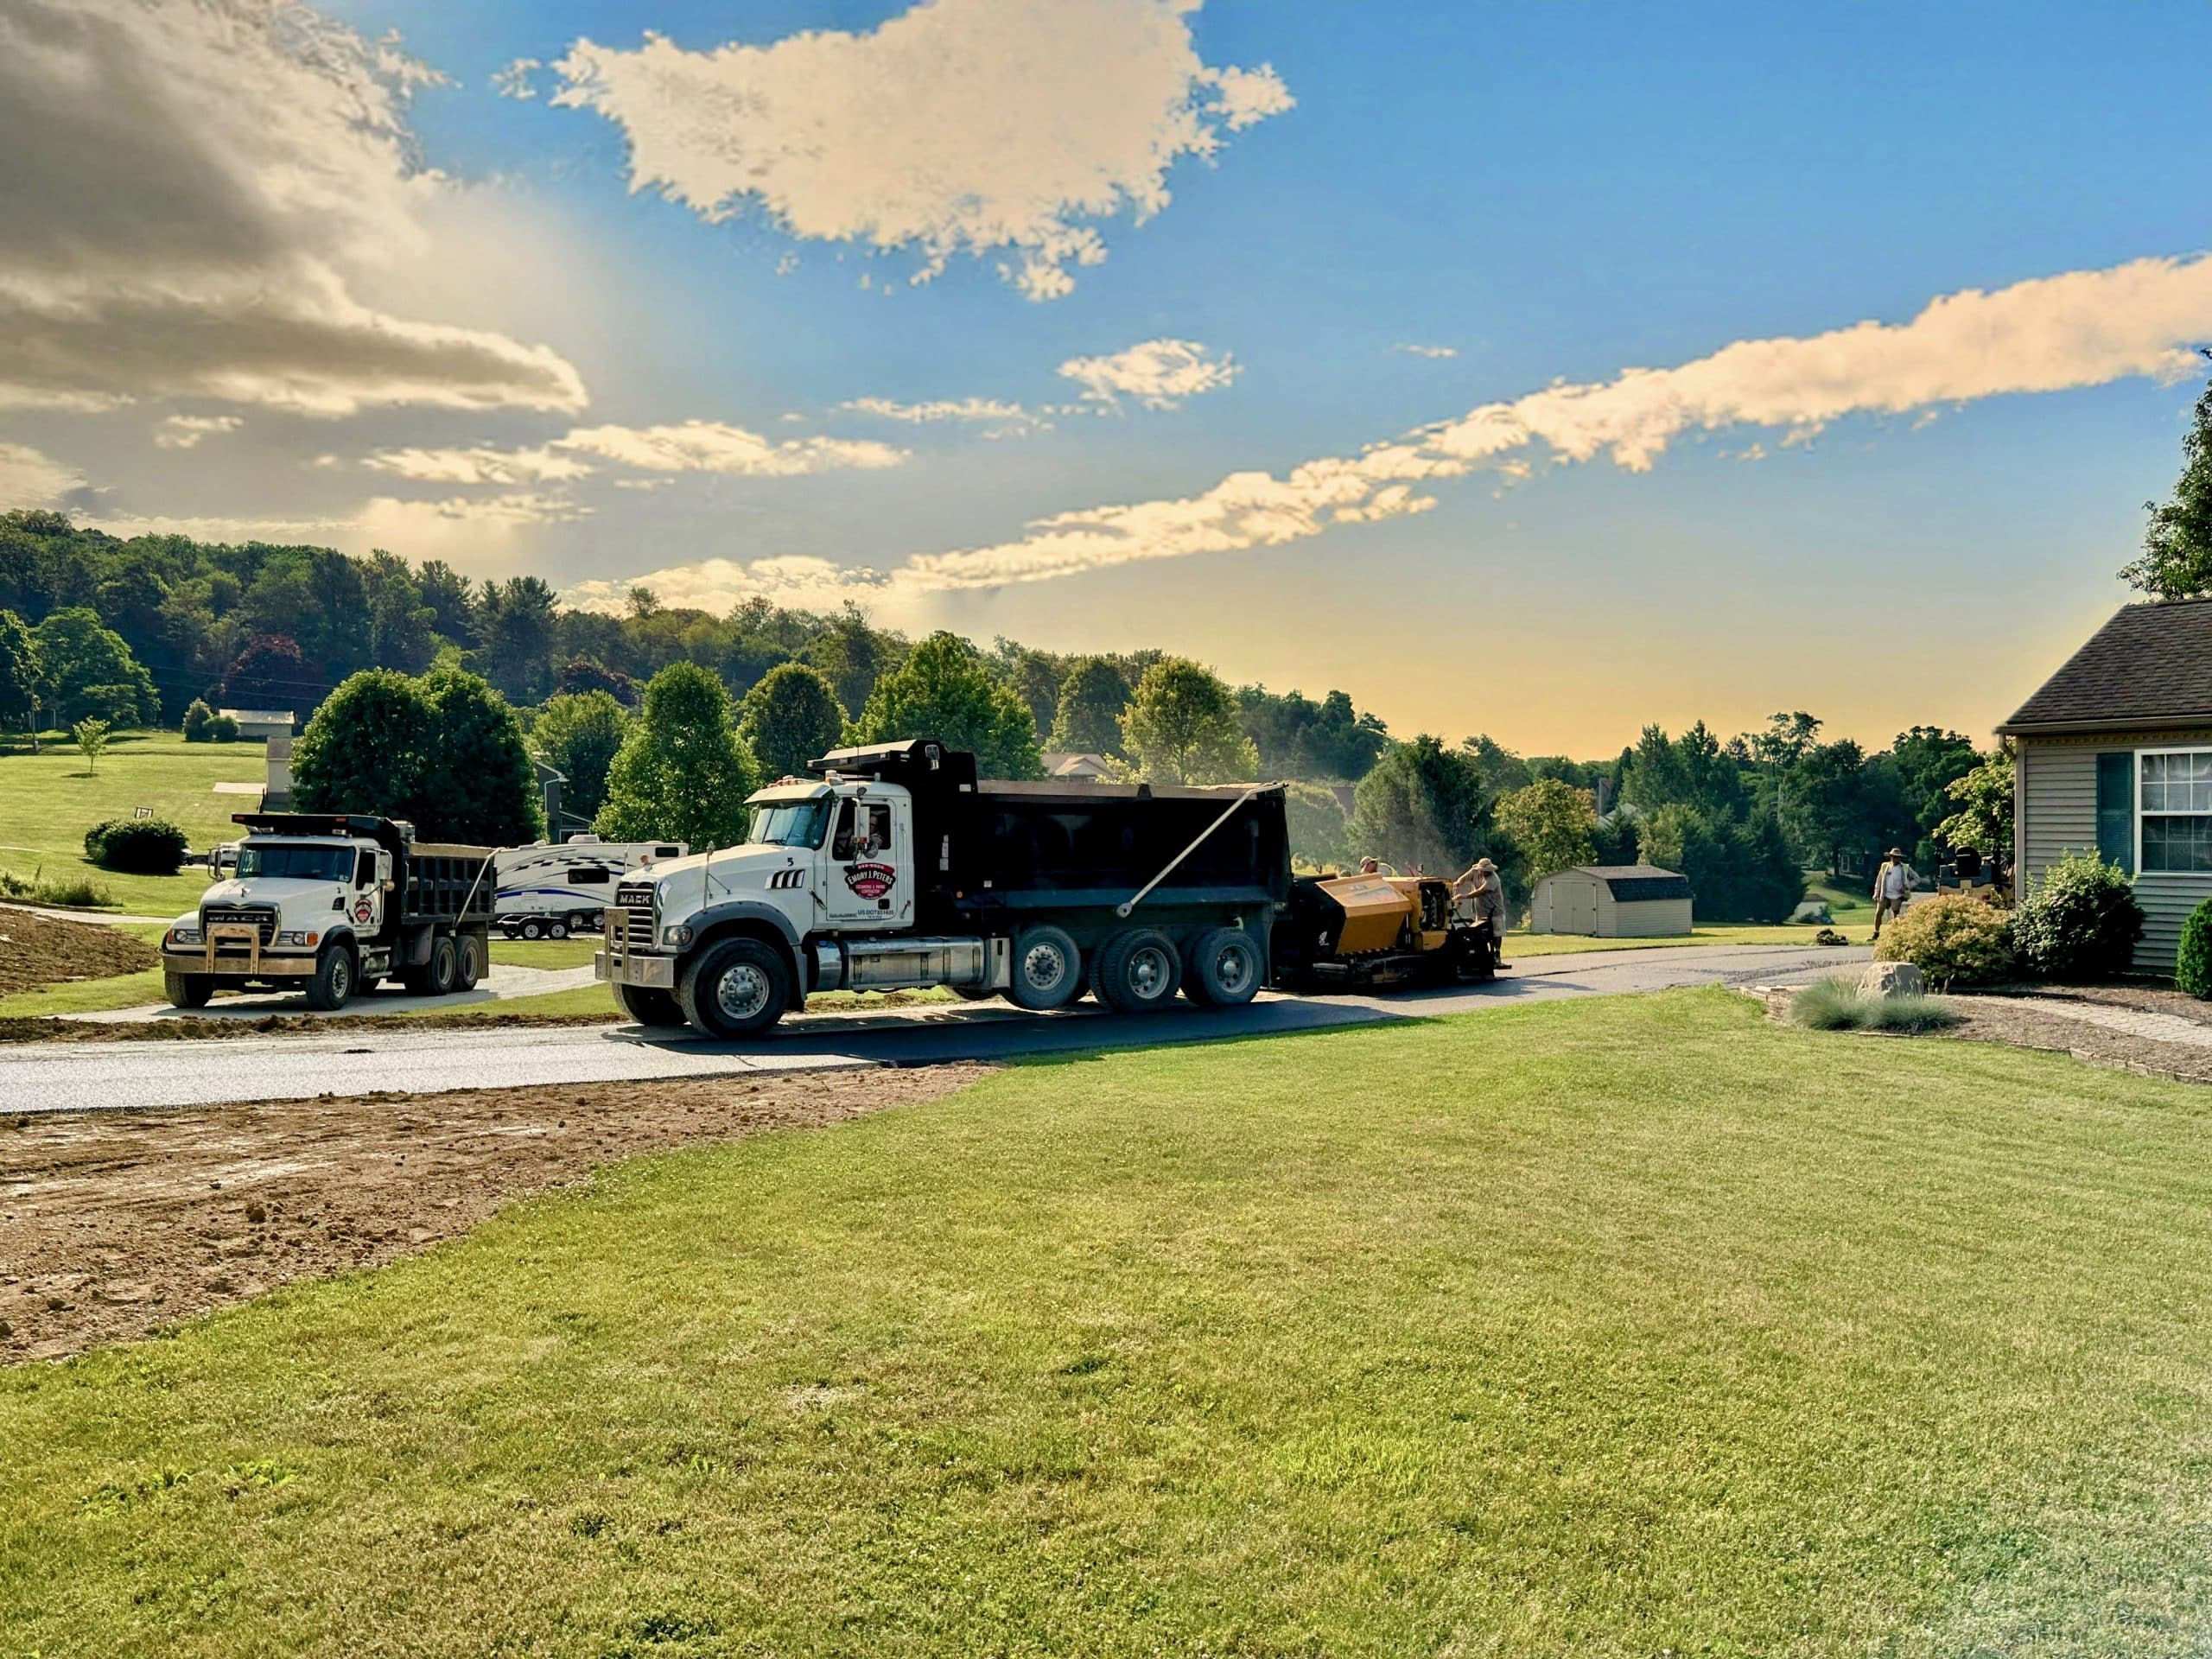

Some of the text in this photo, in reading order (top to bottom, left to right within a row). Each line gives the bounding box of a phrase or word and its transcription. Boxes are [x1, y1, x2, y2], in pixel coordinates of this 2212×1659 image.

[787, 857, 794, 867] 5
[848, 871, 867, 885] EMORY
[874, 870, 893, 885] PETERS
[620, 894, 650, 904] MACK
